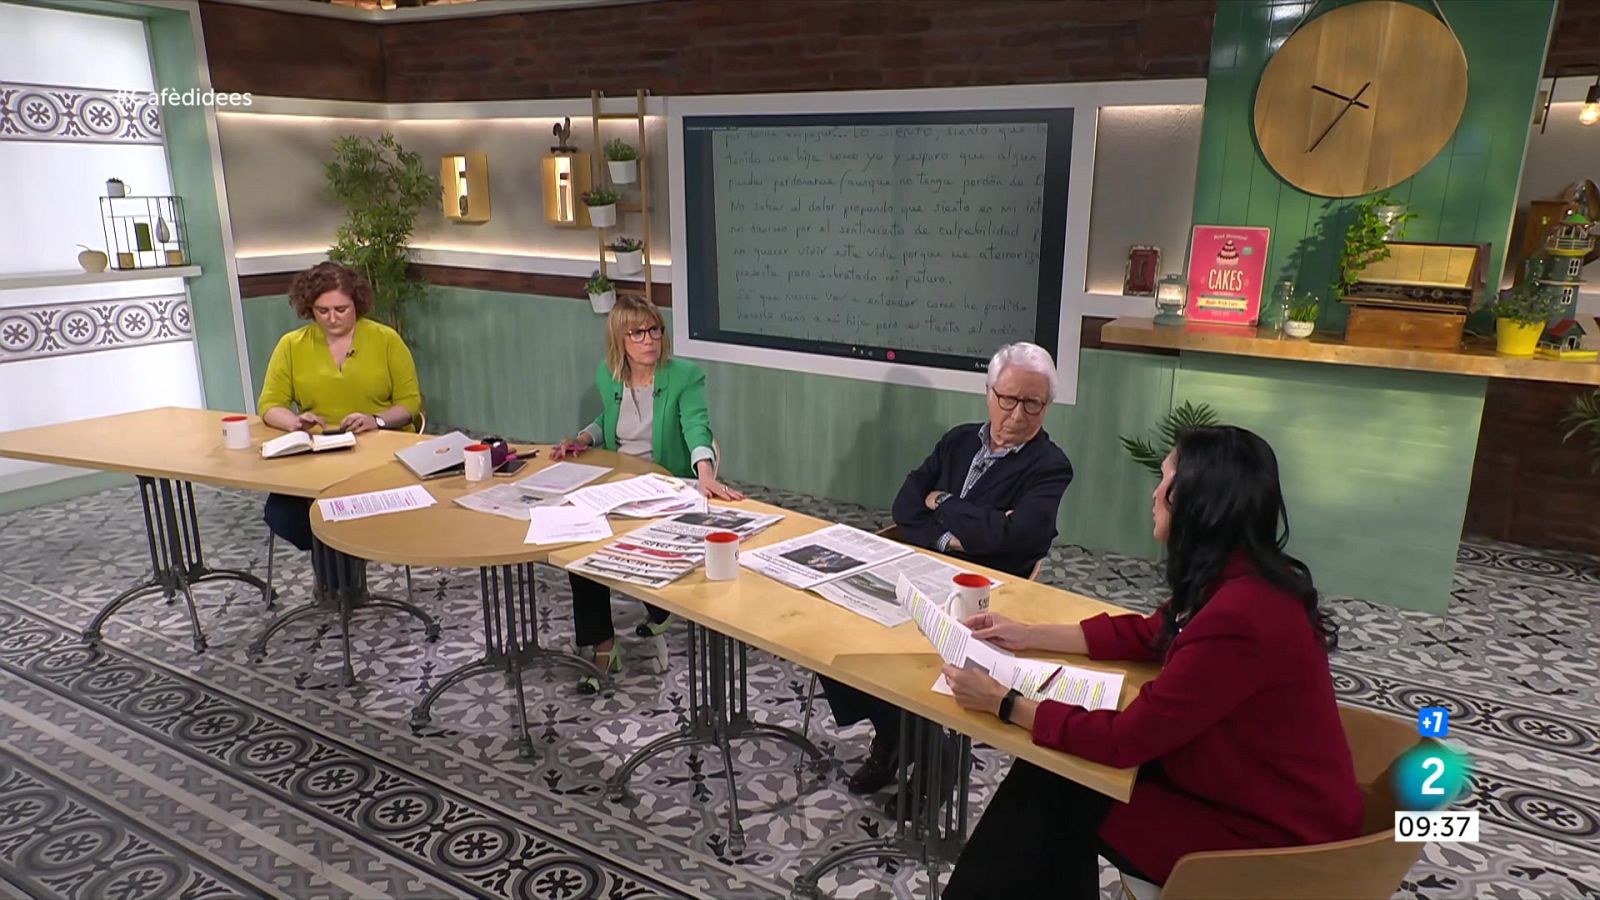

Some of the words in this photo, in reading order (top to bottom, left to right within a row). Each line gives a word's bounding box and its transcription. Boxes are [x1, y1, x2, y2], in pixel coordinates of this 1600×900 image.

[853, 127, 869, 138] LO
[879, 127, 939, 141] SIENTO,
[947, 124, 987, 136] siento
[999, 127, 1025, 140] que
[863, 152, 883, 173] yo
[959, 152, 985, 168] que
[900, 177, 912, 186] no
[1009, 177, 1024, 187] de
[731, 200, 745, 212] No
[808, 197, 835, 211] dolor
[901, 204, 924, 221] que
[933, 197, 970, 213] siento
[1001, 205, 1017, 215] mi
[795, 225, 810, 239] por
[840, 221, 905, 236] sentimiento
[915, 224, 928, 235] de
[938, 220, 1019, 240] culpabilidad
[800, 246, 828, 256] vivir
[867, 247, 898, 260] vida
[903, 252, 941, 267] porque
[1208, 268, 1243, 291] CAKES
[925, 314, 960, 335] tanto
